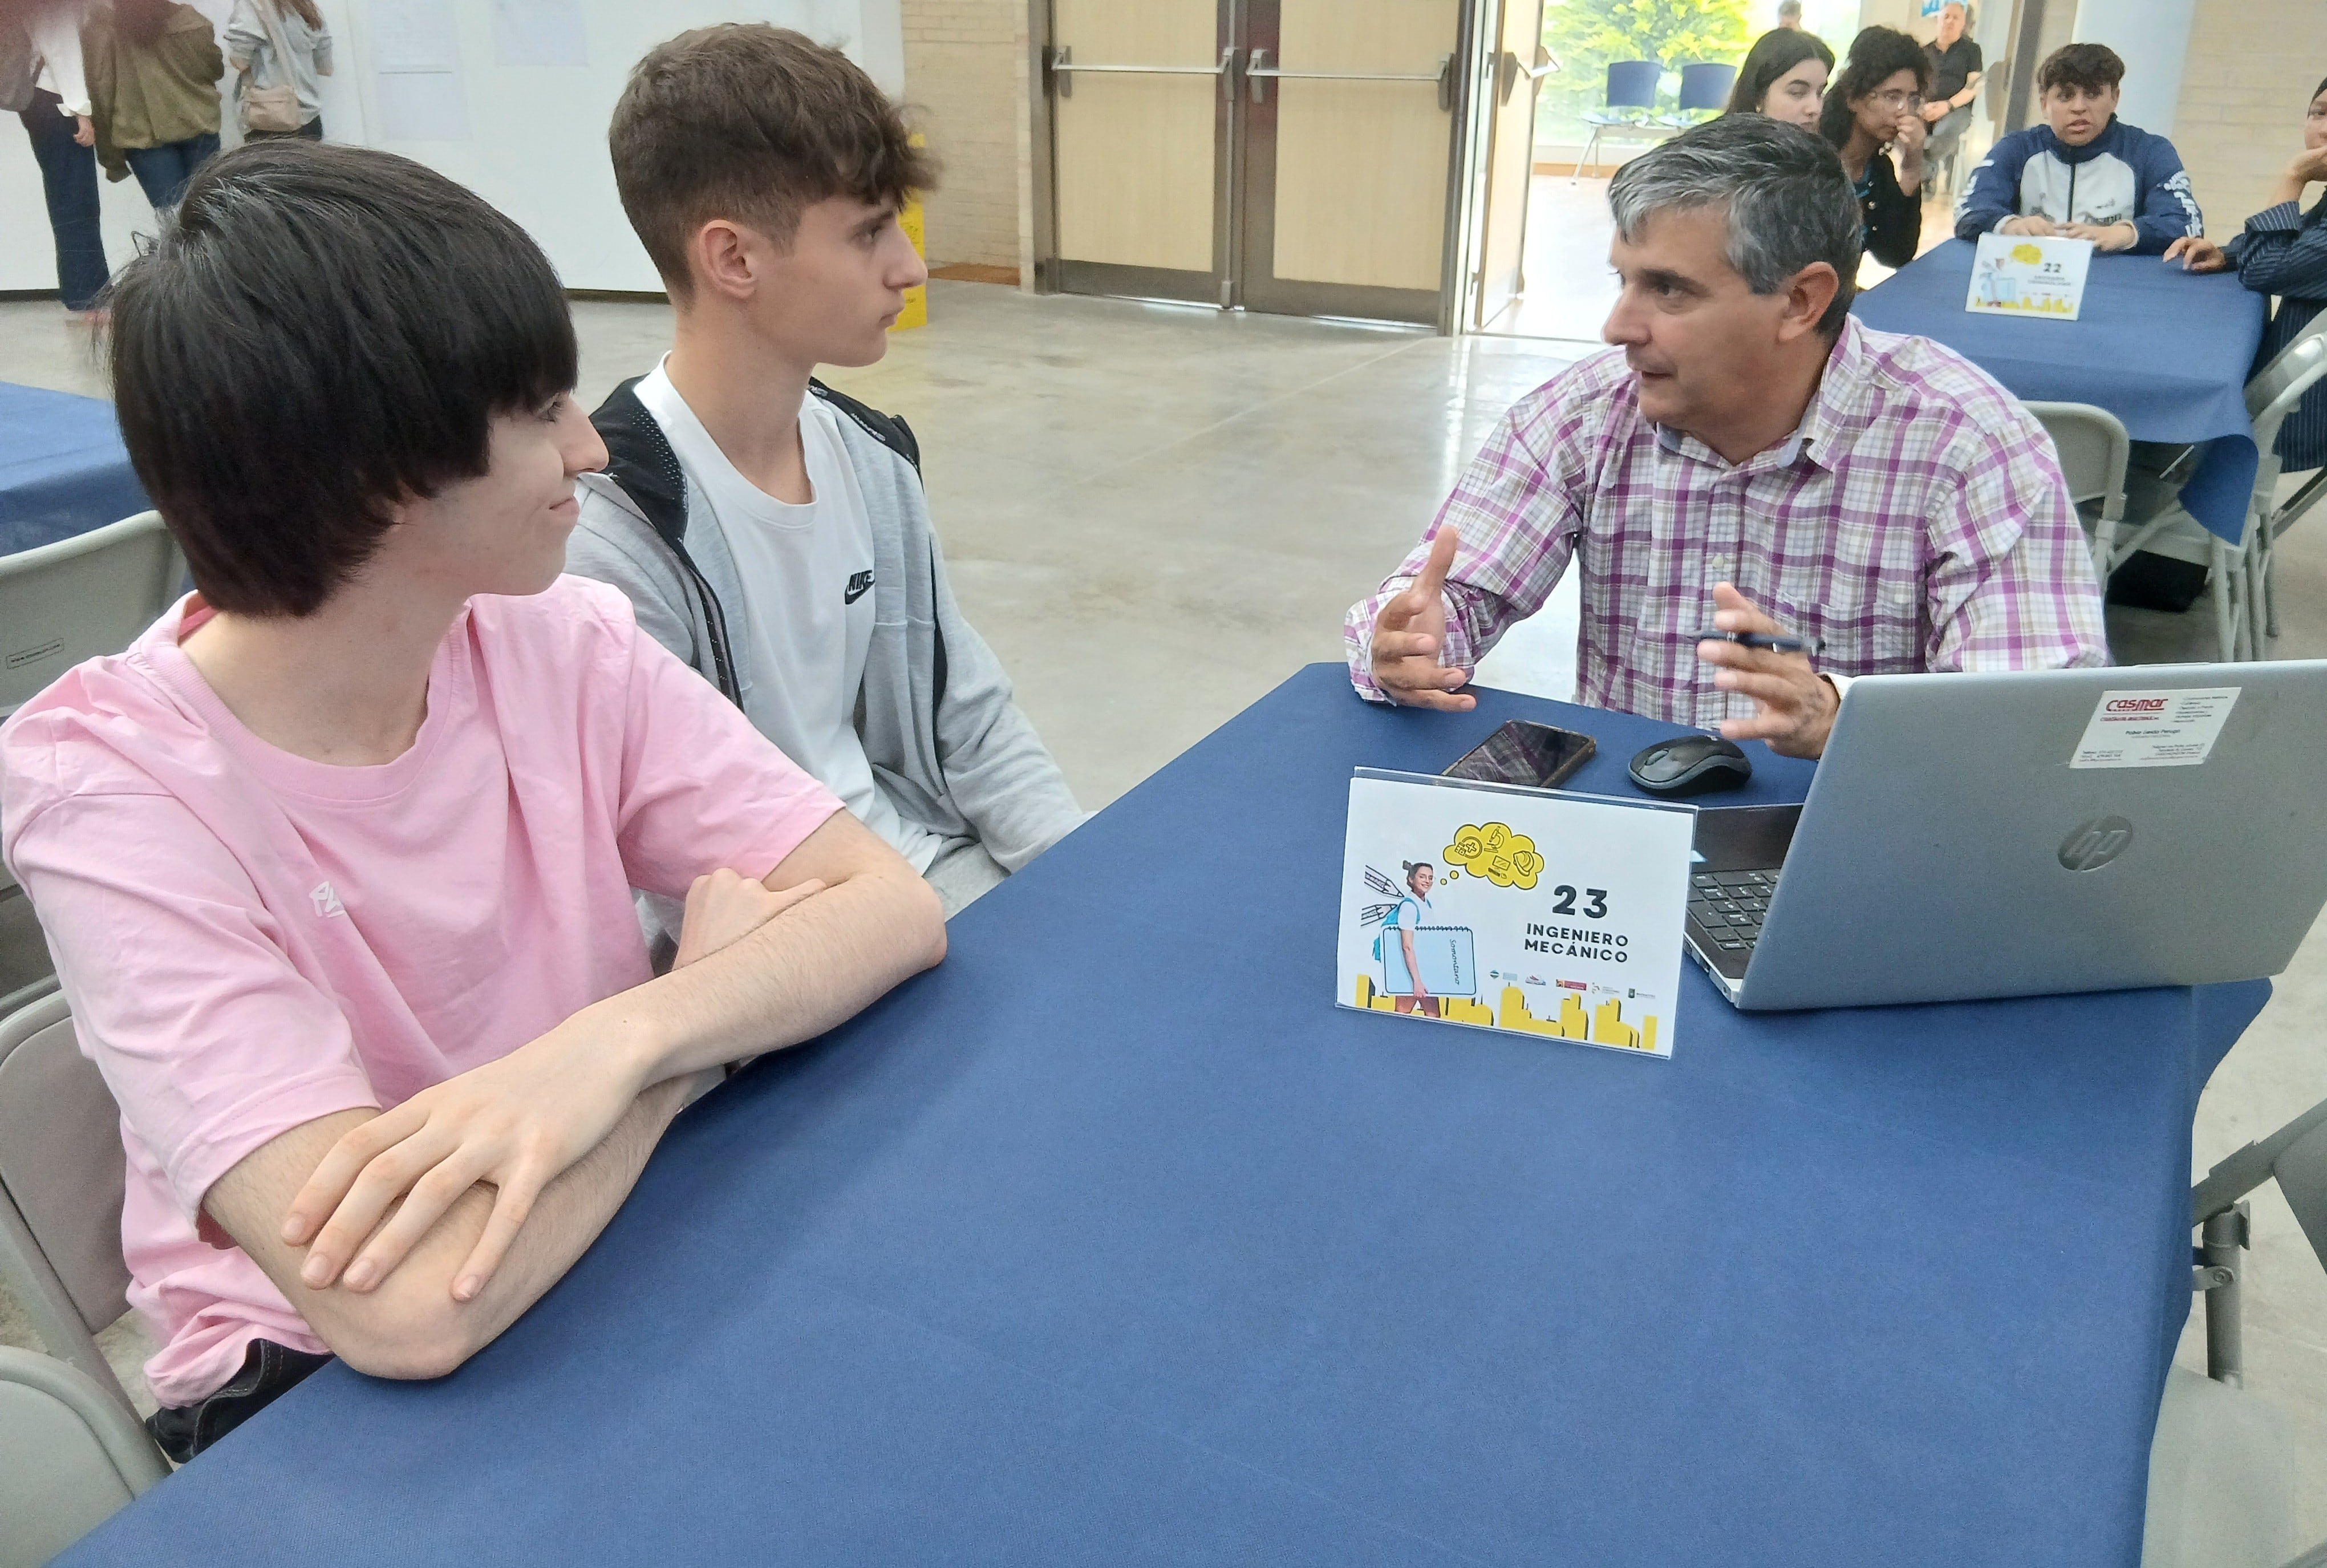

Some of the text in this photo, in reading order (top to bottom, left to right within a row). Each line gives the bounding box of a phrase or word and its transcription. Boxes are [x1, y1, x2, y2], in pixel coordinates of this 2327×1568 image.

[2043, 262, 2062, 273] 22
[849, 570, 873, 591] NIKE
[1552, 885, 1607, 918] 23
[1526, 923, 1628, 946] INGENIERO
[1449, 938, 1460, 985] Somontano
[1525, 938, 1628, 963] MECÁNICO
